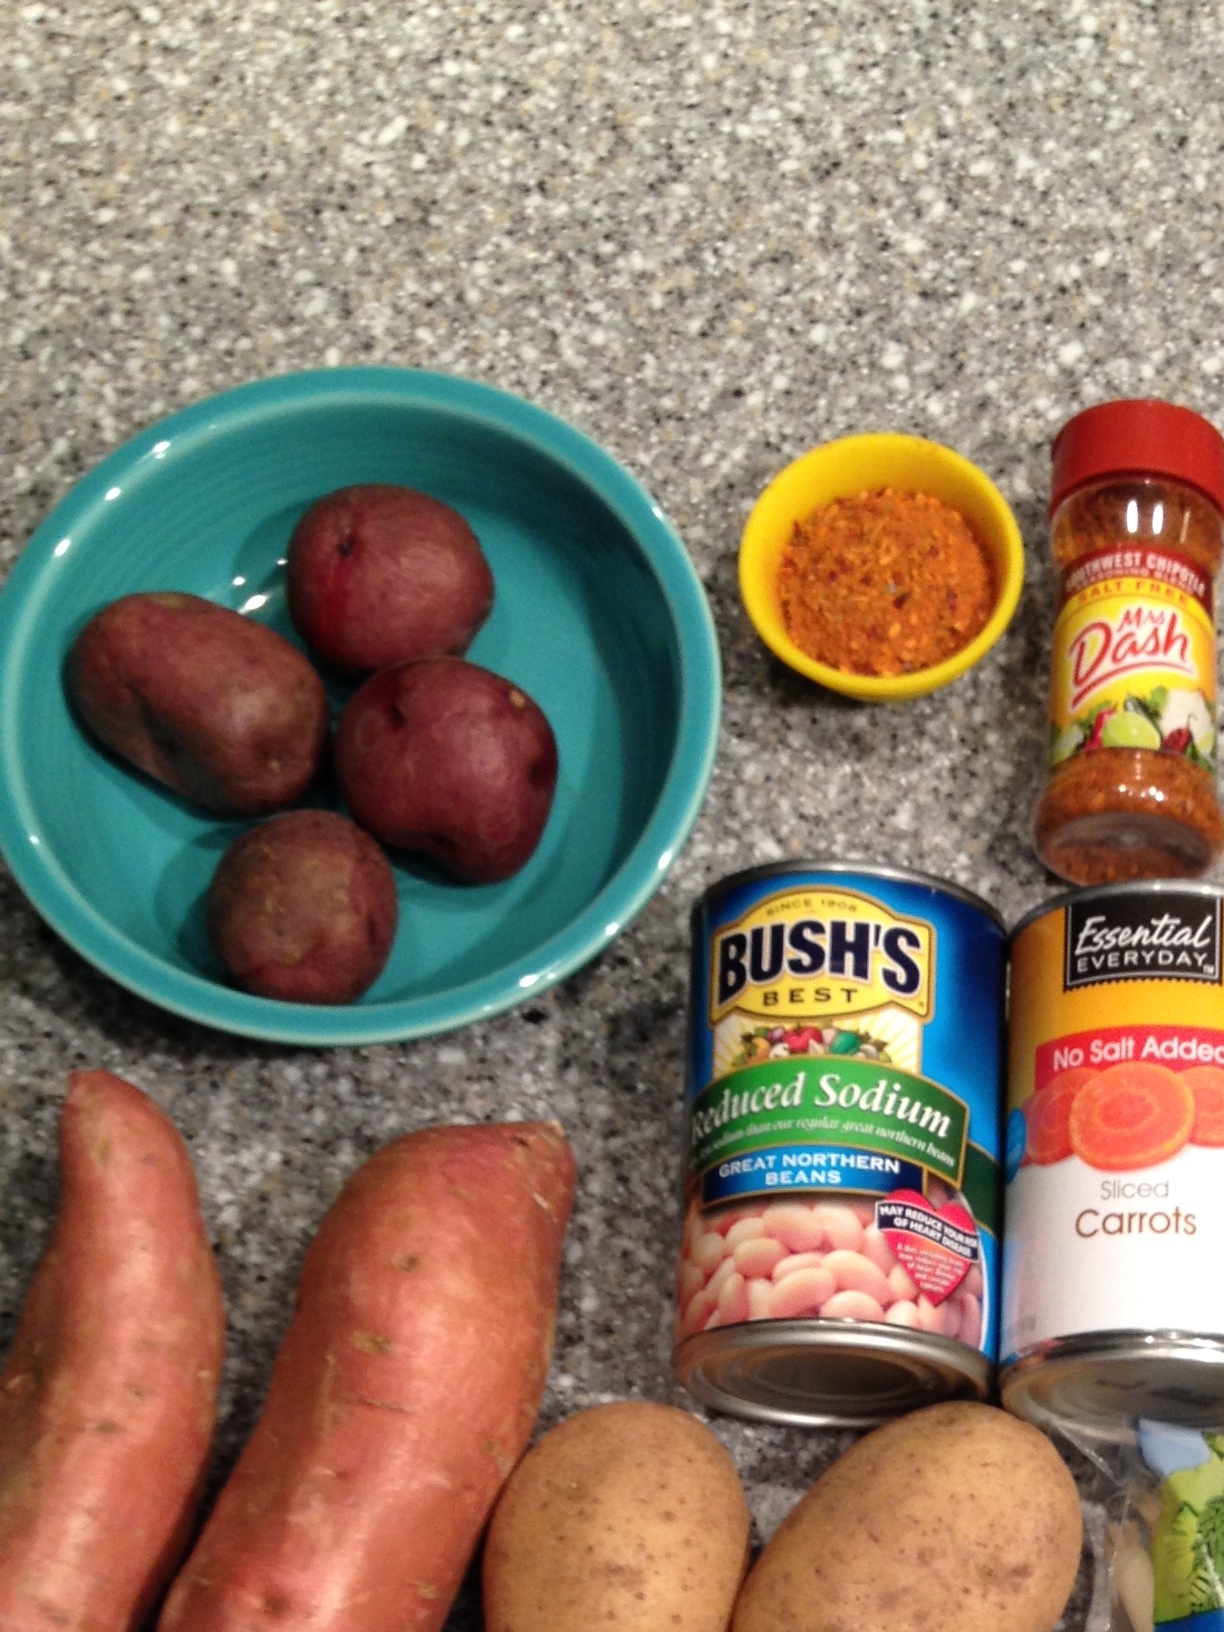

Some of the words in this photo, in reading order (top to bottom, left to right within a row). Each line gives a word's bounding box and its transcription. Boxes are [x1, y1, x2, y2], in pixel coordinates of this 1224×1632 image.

[1069, 613, 1188, 687] Dash
[1074, 912, 1213, 956] Essential
[718, 920, 922, 1005] BUSH'S
[1076, 950, 1208, 974] EVERYDAY
[763, 988, 858, 1006] BEST
[1053, 1044, 1084, 1071] No
[1089, 1037, 1135, 1064] Salt
[814, 1074, 951, 1138] Sodium
[718, 1154, 777, 1178] GREAT
[782, 1152, 900, 1174] NORTHERN
[764, 1170, 842, 1186] BEANS
[1100, 1178, 1169, 1200] Sliced
[880, 1206, 904, 1216] MAY
[904, 1208, 943, 1230] REDUCE
[893, 1217, 909, 1227] OF
[909, 1222, 942, 1240] HEART
[1075, 1206, 1197, 1237] Carrots
